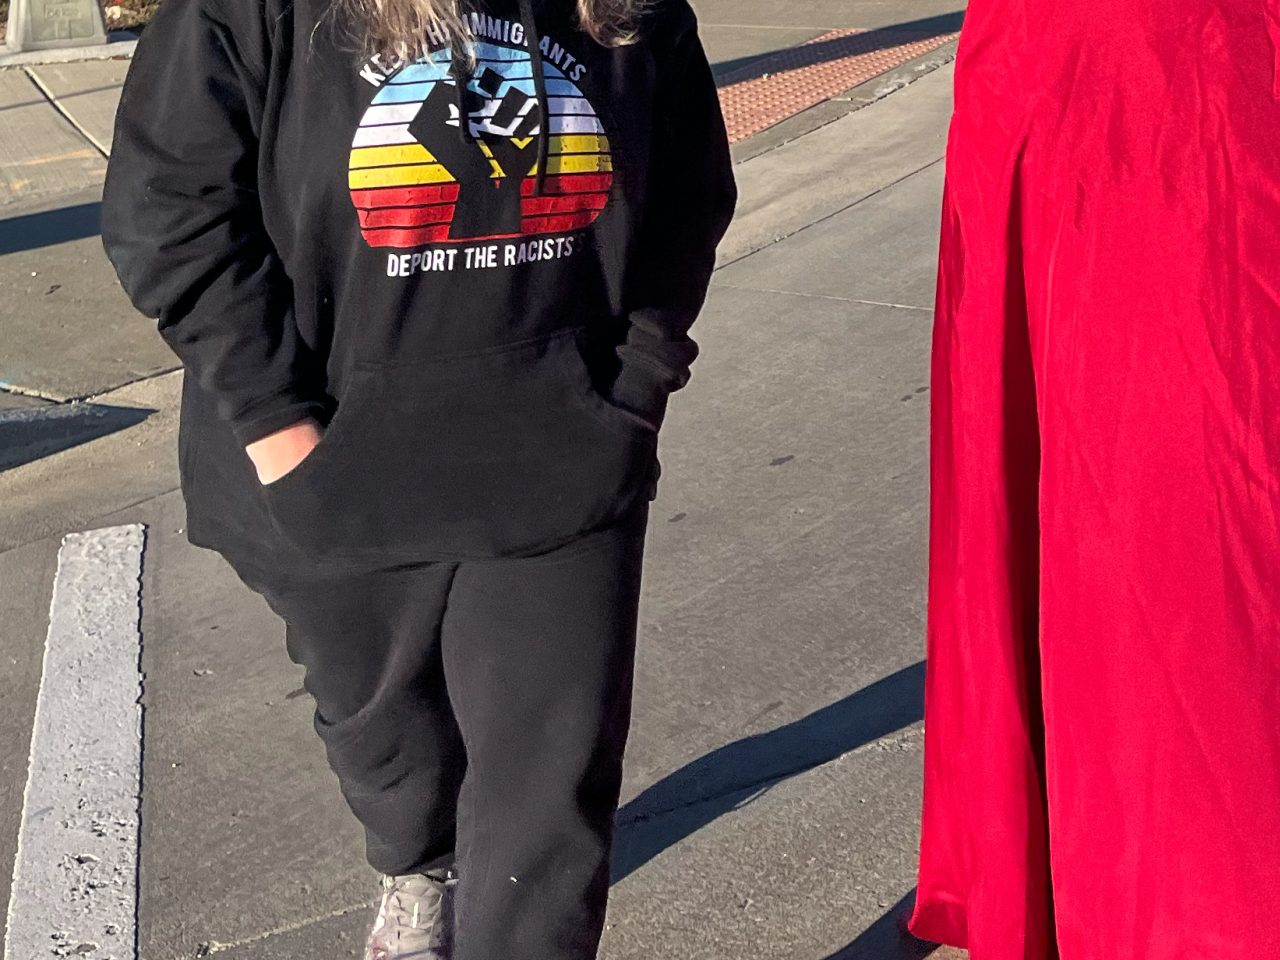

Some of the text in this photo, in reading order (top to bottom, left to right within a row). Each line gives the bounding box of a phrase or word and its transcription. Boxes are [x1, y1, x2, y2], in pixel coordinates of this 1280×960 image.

[461, 12, 587, 81] IMMIGANTS
[386, 236, 575, 277] DEPORT THE RACISTS
